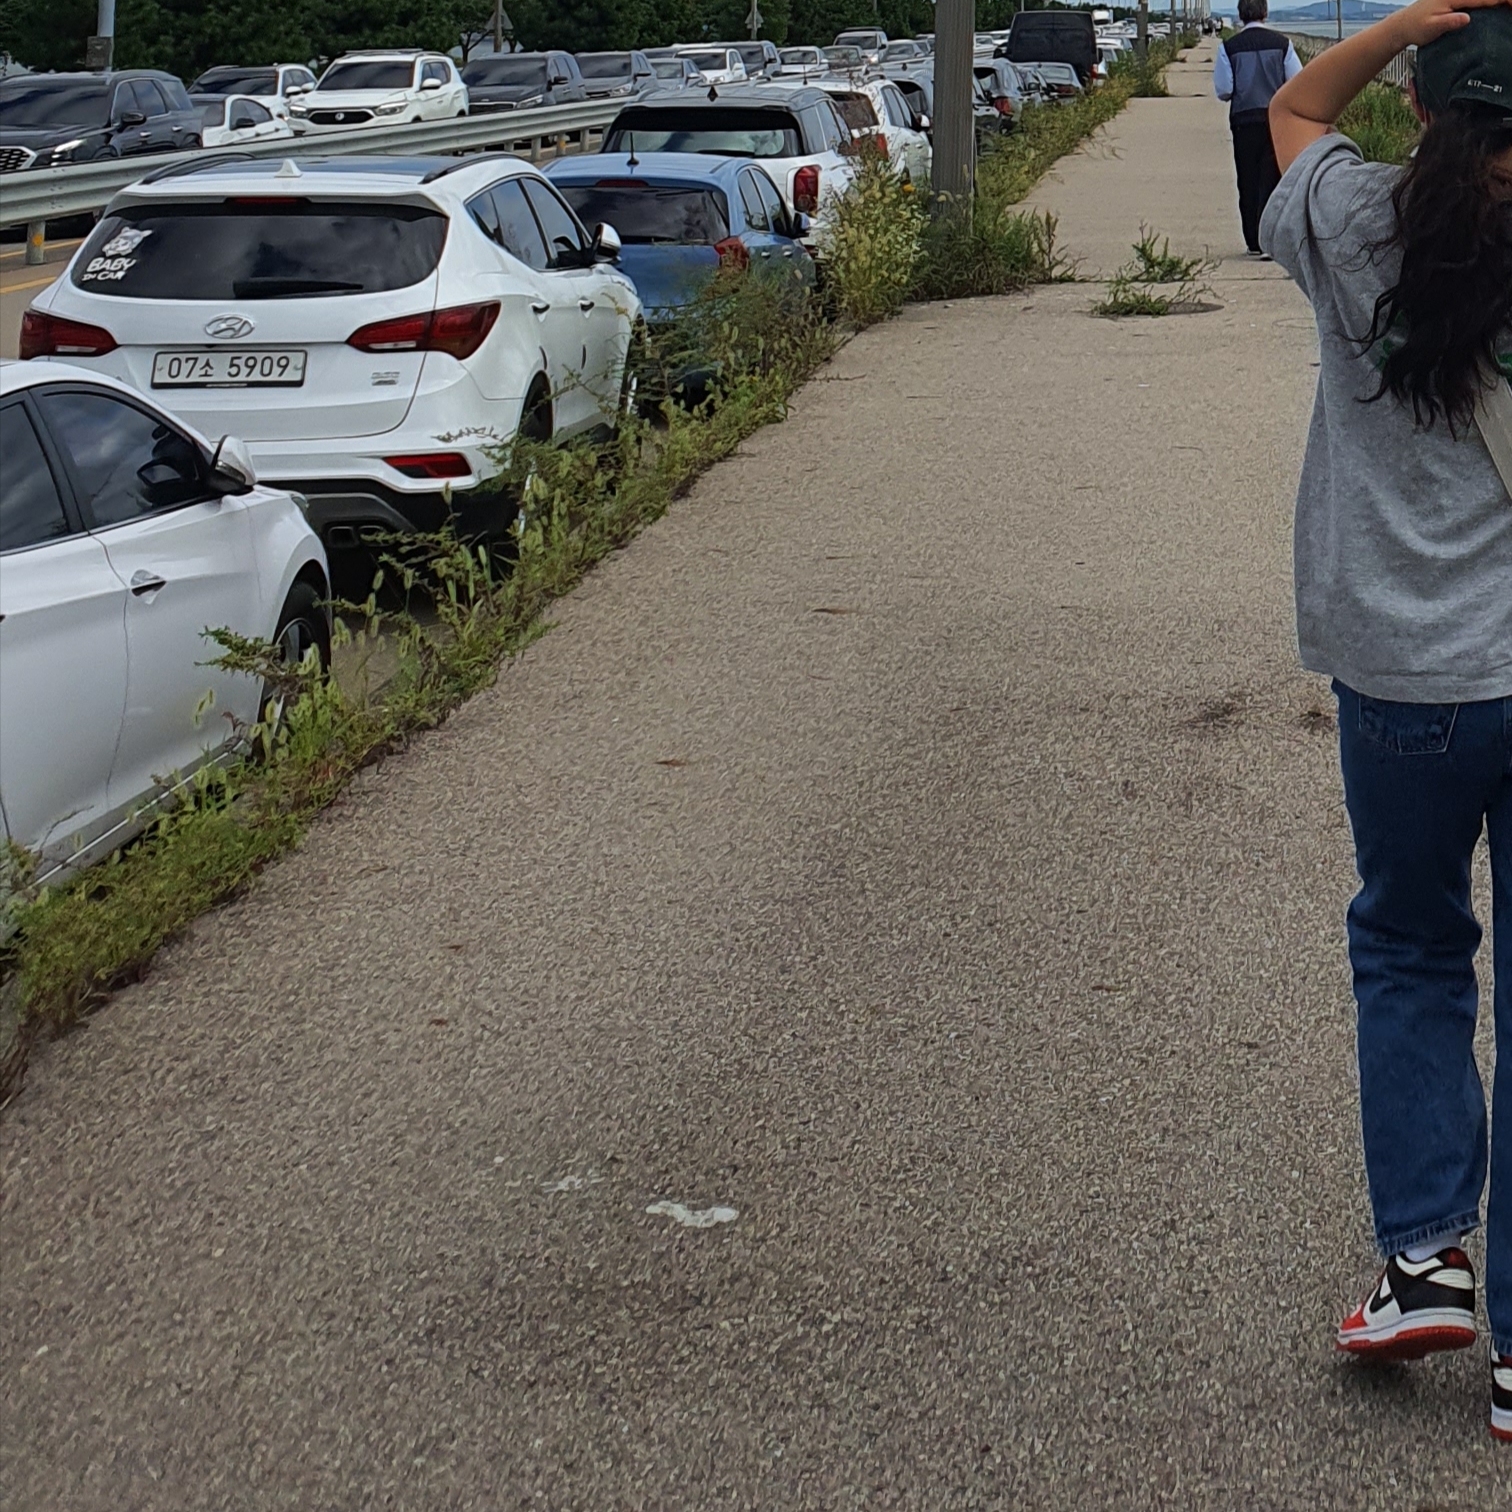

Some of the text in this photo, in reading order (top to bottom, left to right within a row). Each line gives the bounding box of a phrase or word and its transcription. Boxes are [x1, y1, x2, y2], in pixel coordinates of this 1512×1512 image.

[86, 257, 137, 273] BABY
[167, 355, 290, 379] 07소 5909
